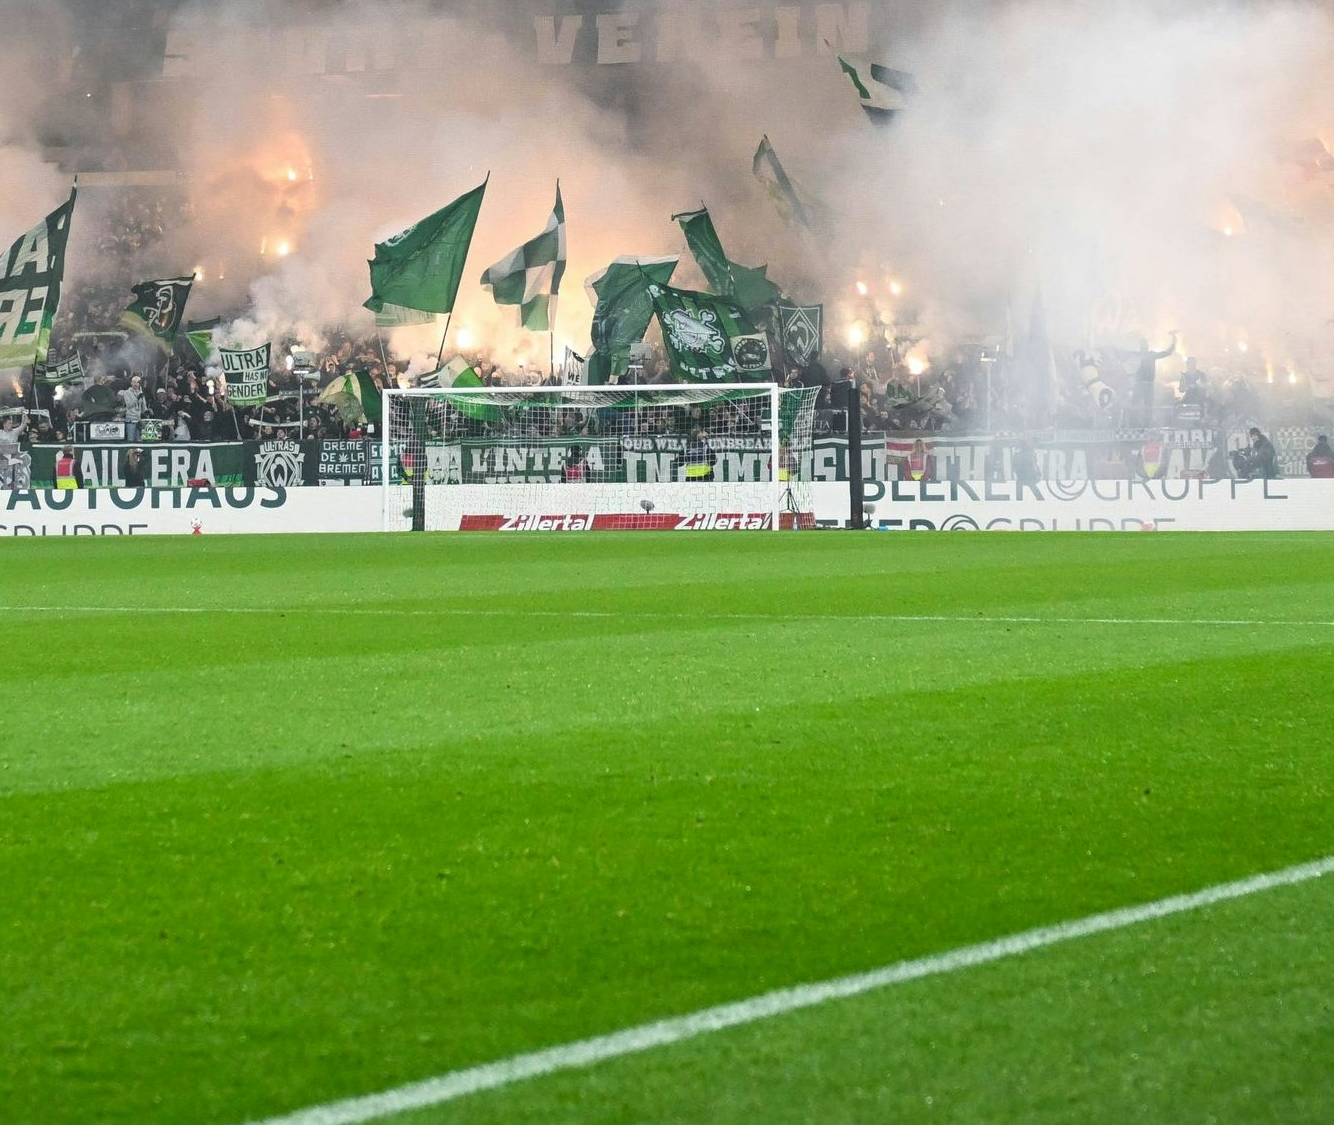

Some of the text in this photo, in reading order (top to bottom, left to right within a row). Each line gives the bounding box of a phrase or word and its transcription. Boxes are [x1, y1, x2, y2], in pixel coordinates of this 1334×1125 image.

[321, 452, 365, 462] DE LA
[319, 463, 366, 473] BREMEN
[499, 514, 594, 531] Zillertal
